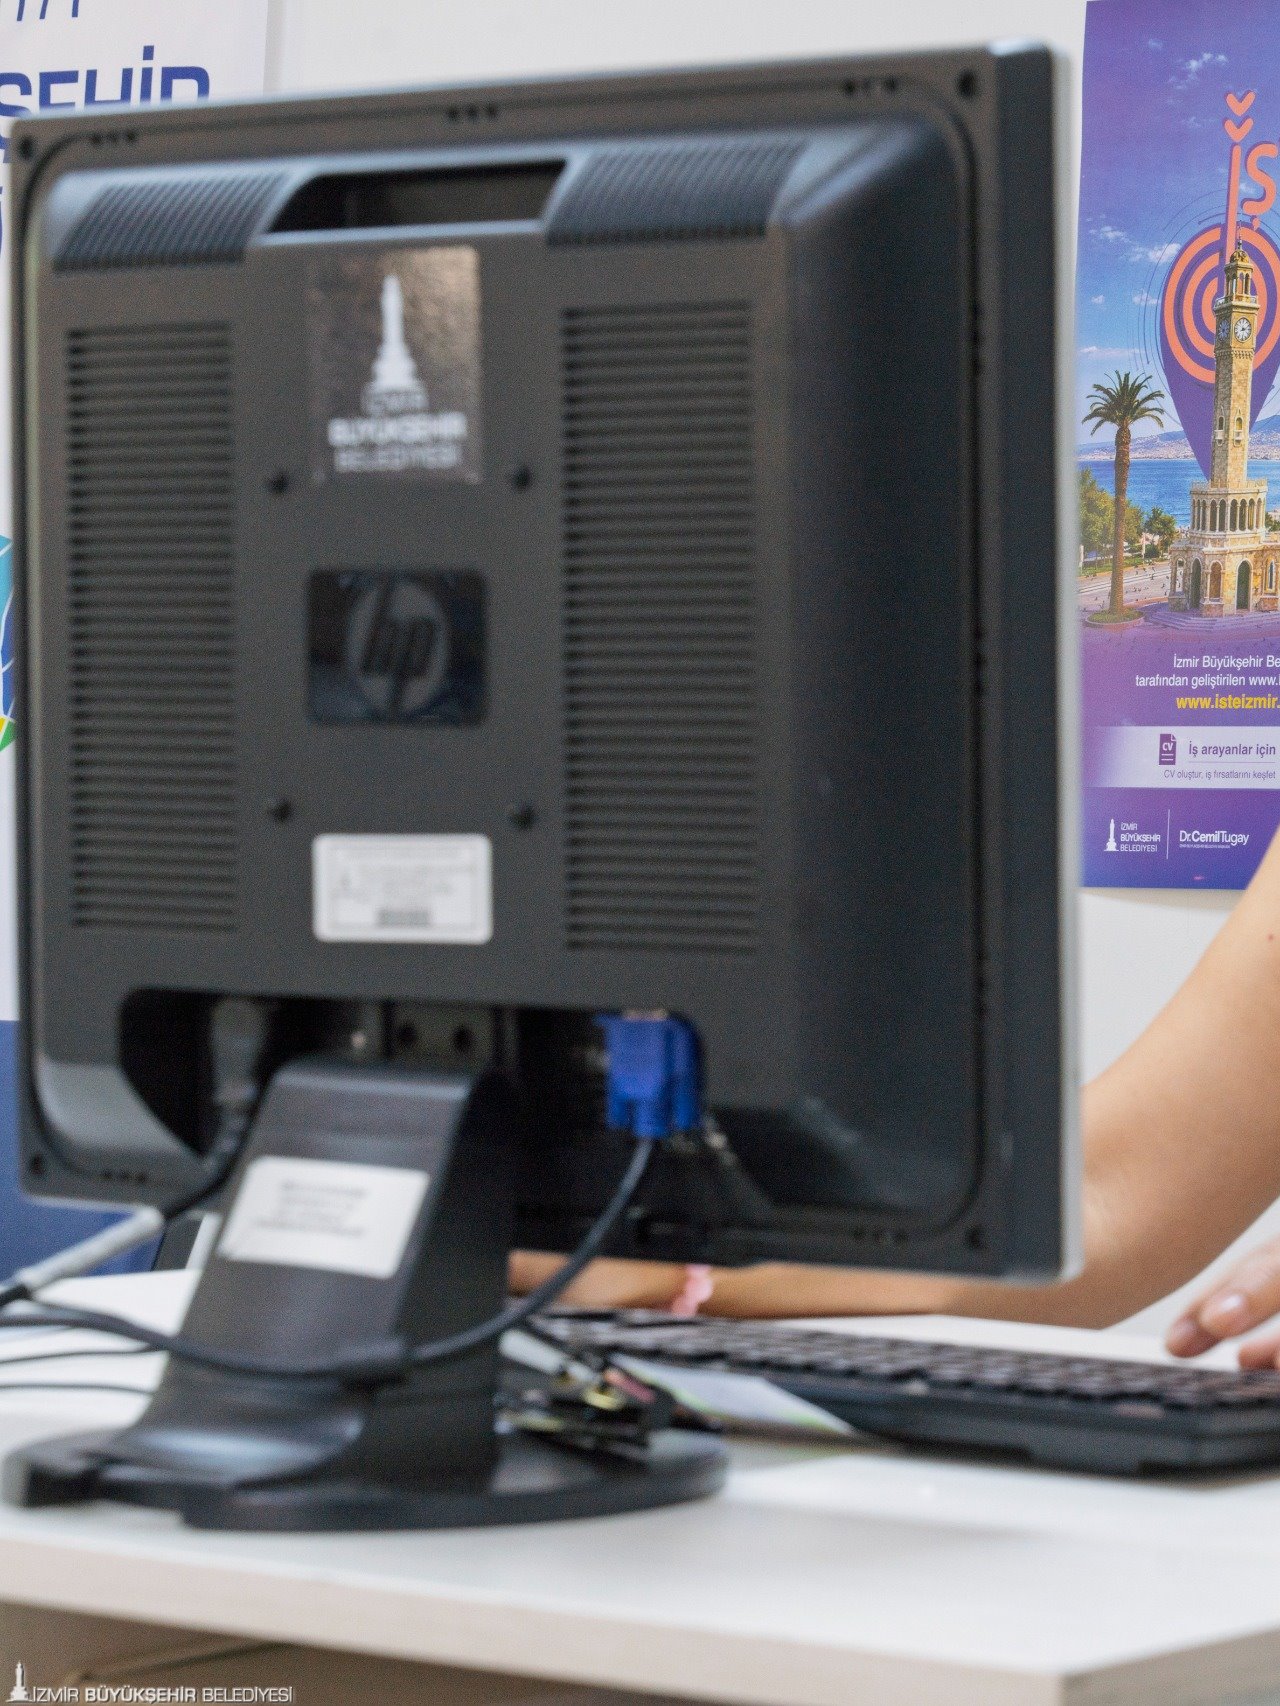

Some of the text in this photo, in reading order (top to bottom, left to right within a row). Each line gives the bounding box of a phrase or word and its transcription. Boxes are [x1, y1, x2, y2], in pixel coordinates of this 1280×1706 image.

[1173, 653, 1200, 668] İzmir
[1202, 654, 1264, 671] Büyükşehir
[1135, 673, 1189, 687] tarafından
[1191, 673, 1246, 690] geliştirilen
[1162, 742, 1174, 751] CV
[1188, 740, 1276, 759] İş arayanlar için
[1163, 769, 1176, 779] CV
[1252, 769, 1276, 780] keşfet
